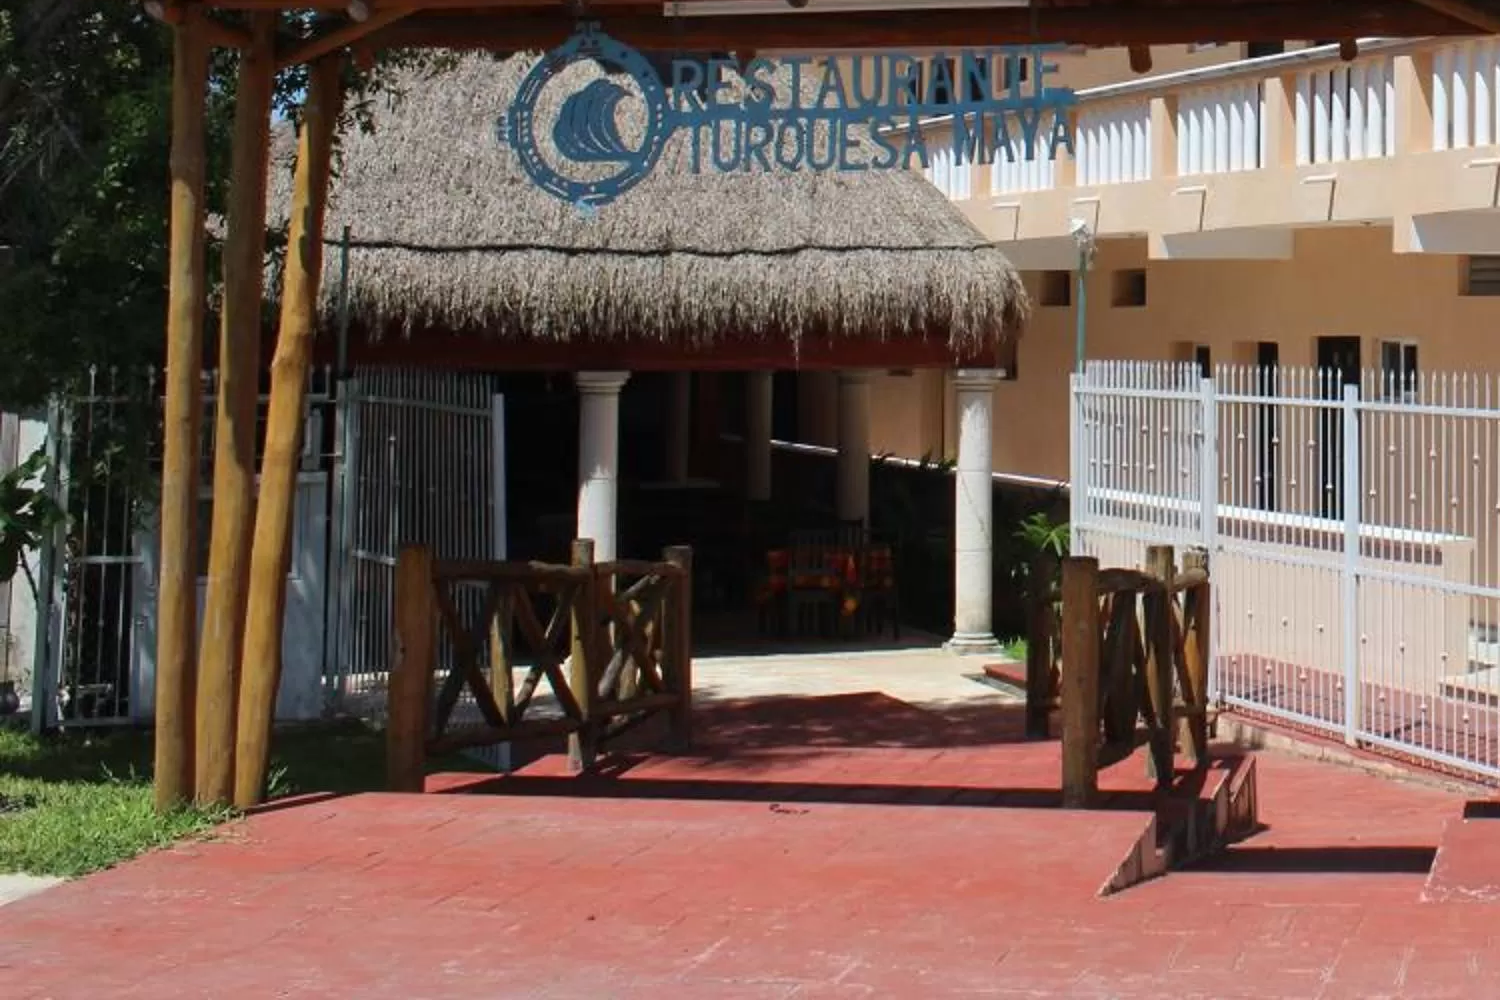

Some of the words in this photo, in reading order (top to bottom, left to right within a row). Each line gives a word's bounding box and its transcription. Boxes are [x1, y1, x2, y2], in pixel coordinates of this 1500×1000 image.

[671, 43, 1070, 111] RESTAURANTE
[682, 112, 929, 174] TURQUESA
[953, 104, 1075, 166] MAYA
